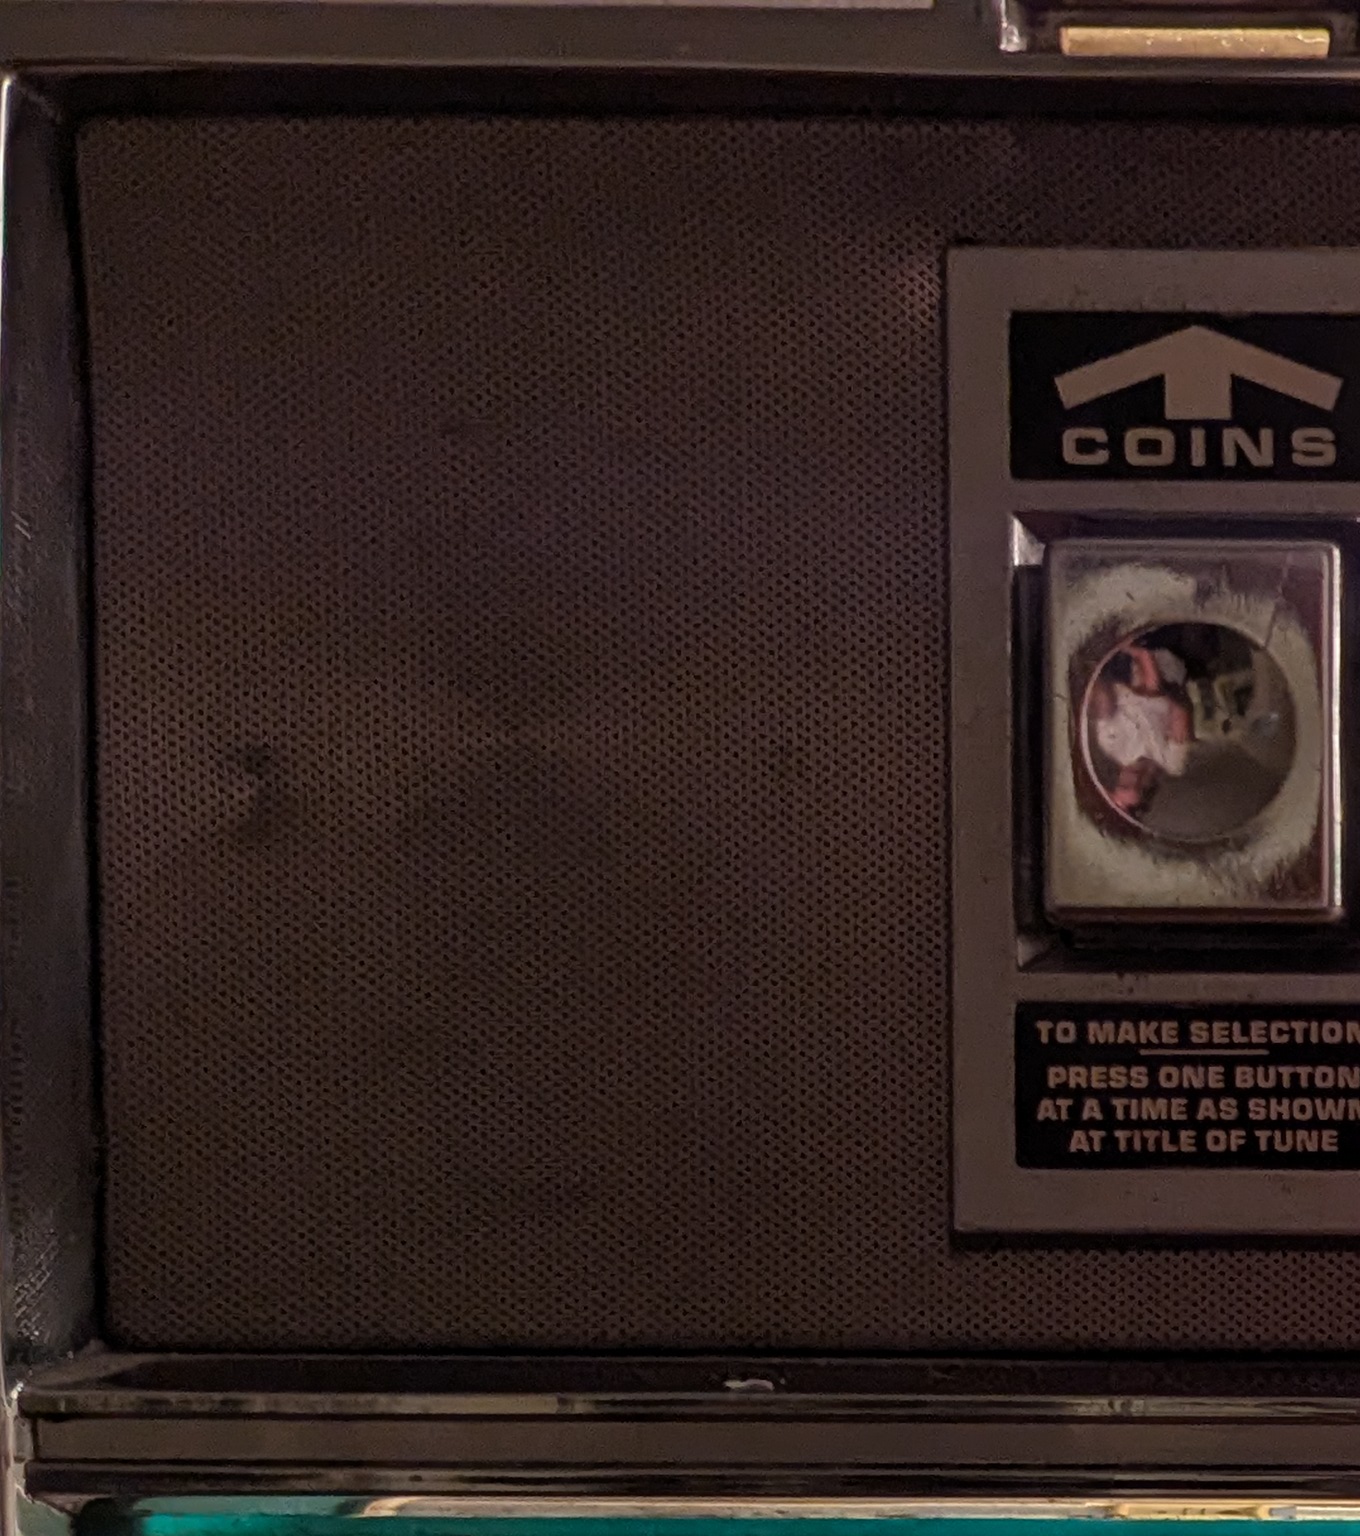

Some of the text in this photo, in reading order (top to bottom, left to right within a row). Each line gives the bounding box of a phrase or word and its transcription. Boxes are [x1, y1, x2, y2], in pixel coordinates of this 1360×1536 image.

[1062, 427, 1337, 467] COINS
[1036, 1020, 1077, 1044] TO
[1087, 1020, 1179, 1044] MAKE
[1047, 1065, 1360, 1089] PRESS ONE BUTTON
[1036, 1098, 1074, 1121] AT
[1081, 1097, 1103, 1121] A
[1111, 1097, 1188, 1121] TIME
[1196, 1097, 1238, 1121] AS
[1069, 1129, 1339, 1153] AT TITLE OF TUNE
